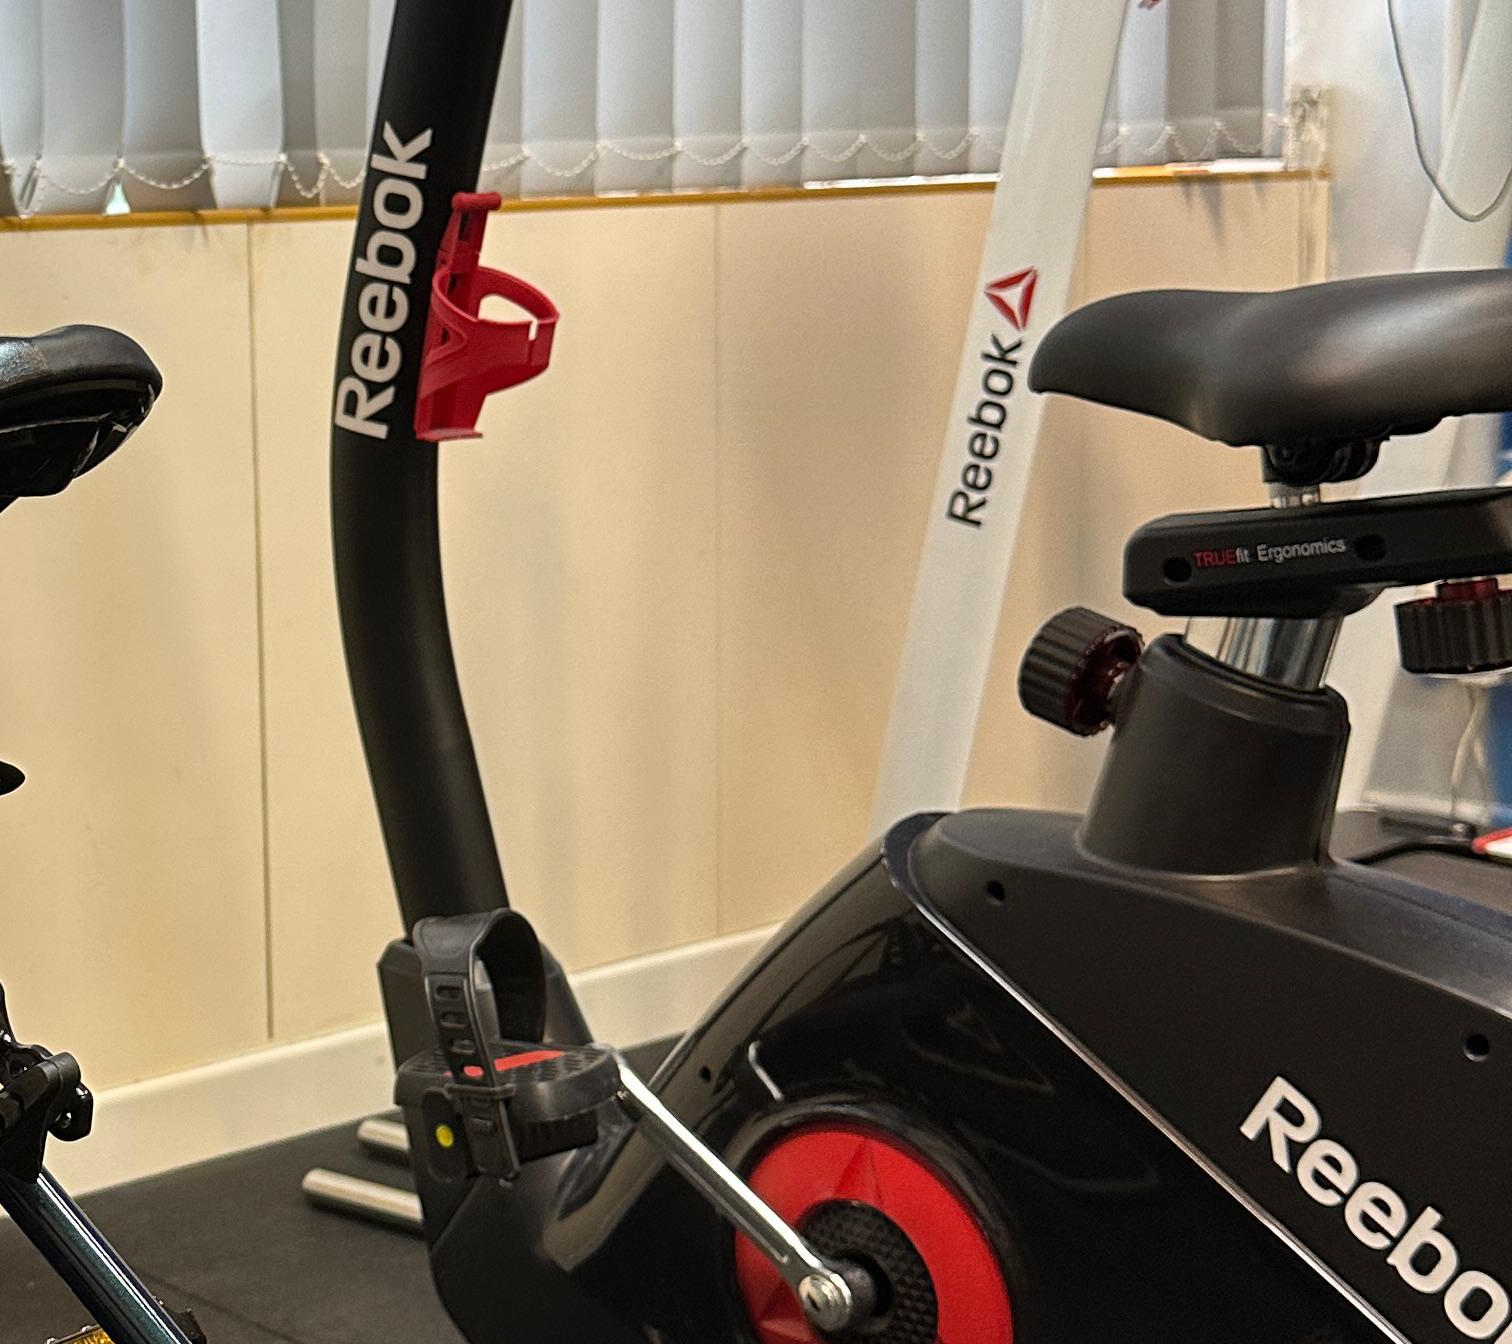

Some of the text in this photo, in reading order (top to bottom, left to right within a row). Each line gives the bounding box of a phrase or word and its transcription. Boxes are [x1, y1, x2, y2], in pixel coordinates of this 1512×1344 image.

[334, 120, 433, 439] Reebok
[946, 334, 1024, 529] Reebok
[1256, 537, 1347, 564] Ergonomics
